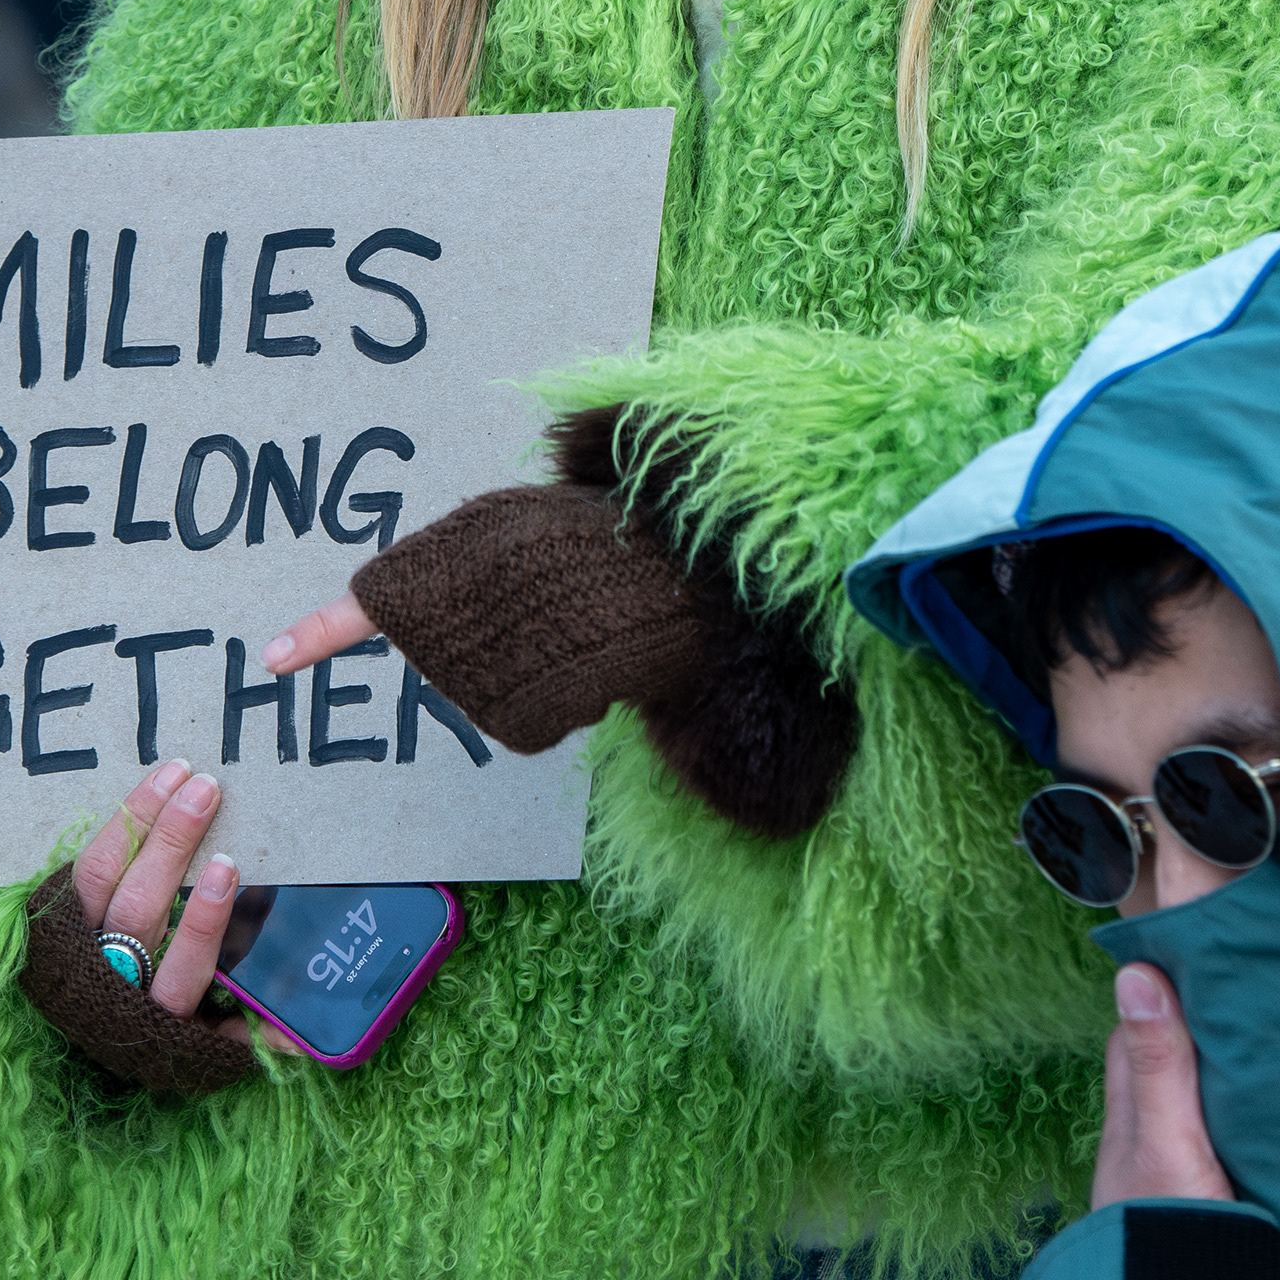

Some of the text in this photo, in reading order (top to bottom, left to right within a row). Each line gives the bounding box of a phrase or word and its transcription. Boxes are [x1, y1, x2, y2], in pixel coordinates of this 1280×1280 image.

[307, 898, 378, 991] 4:15
[346, 936, 384, 984] Mon Jan 26
